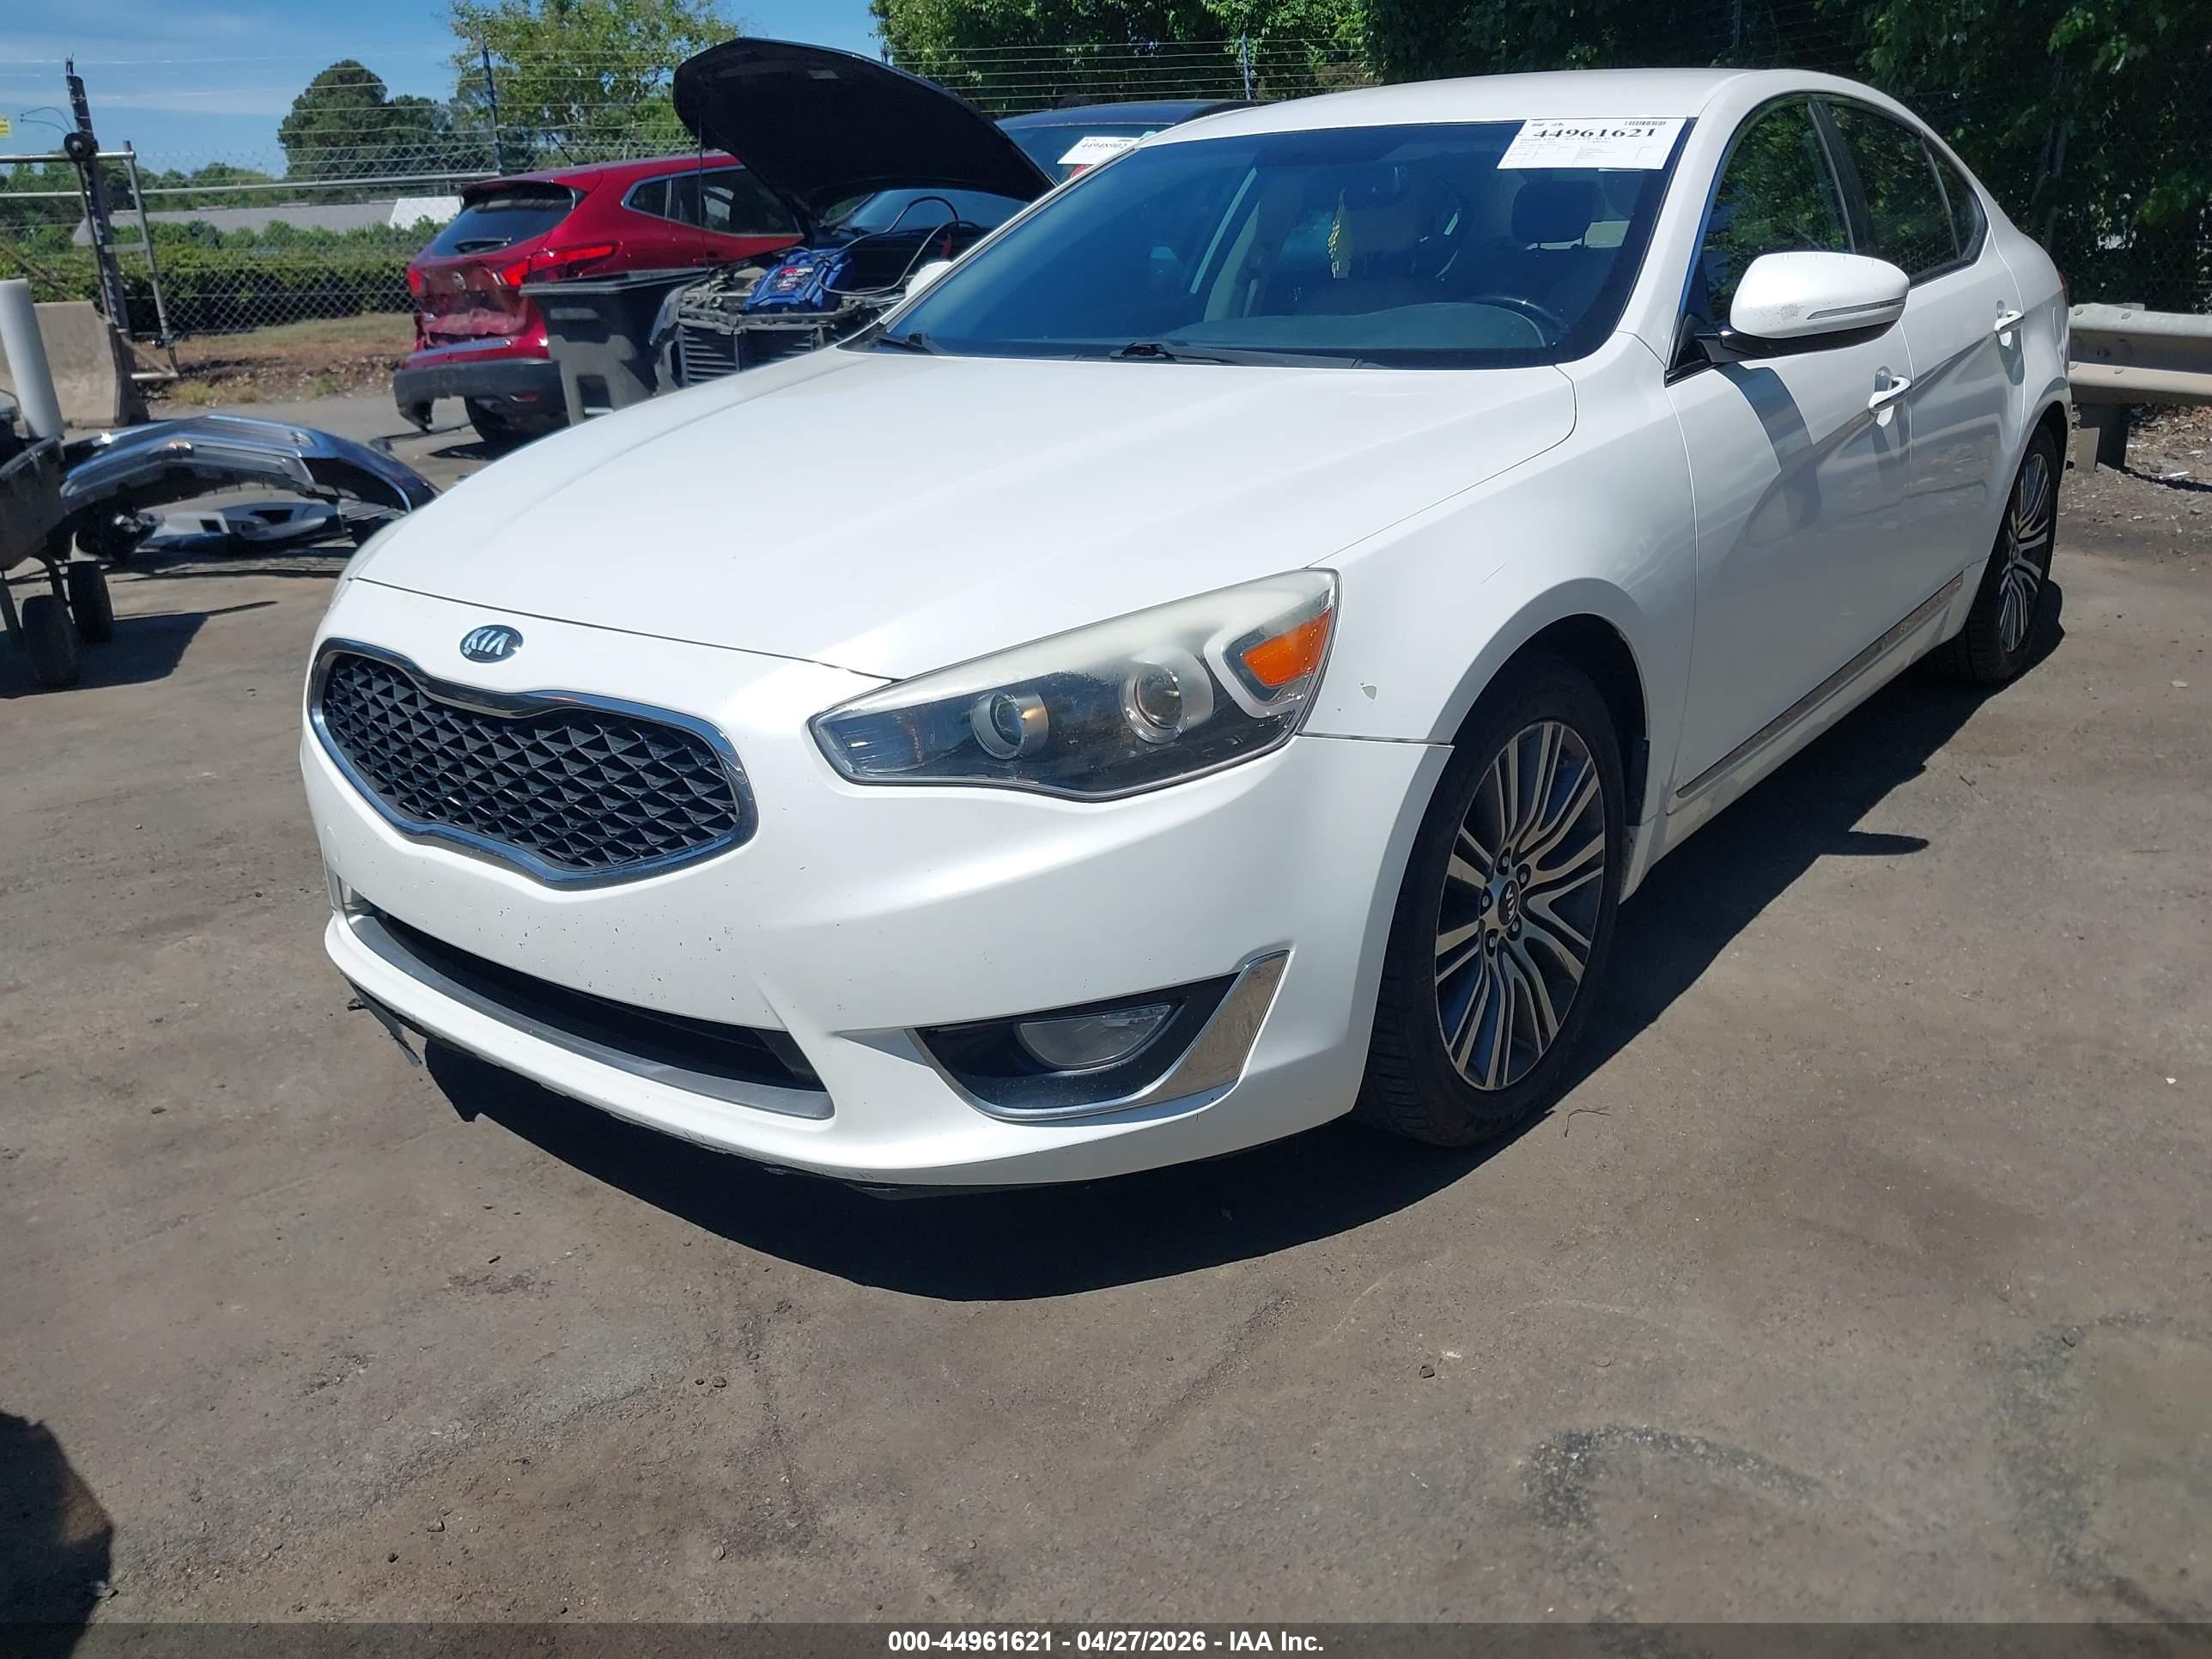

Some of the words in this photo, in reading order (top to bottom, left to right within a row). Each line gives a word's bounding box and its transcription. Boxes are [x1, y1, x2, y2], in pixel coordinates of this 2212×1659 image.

[1533, 128, 1655, 138] 44961621
[465, 629, 510, 655] KIA
[1505, 886, 1516, 920] KIA
